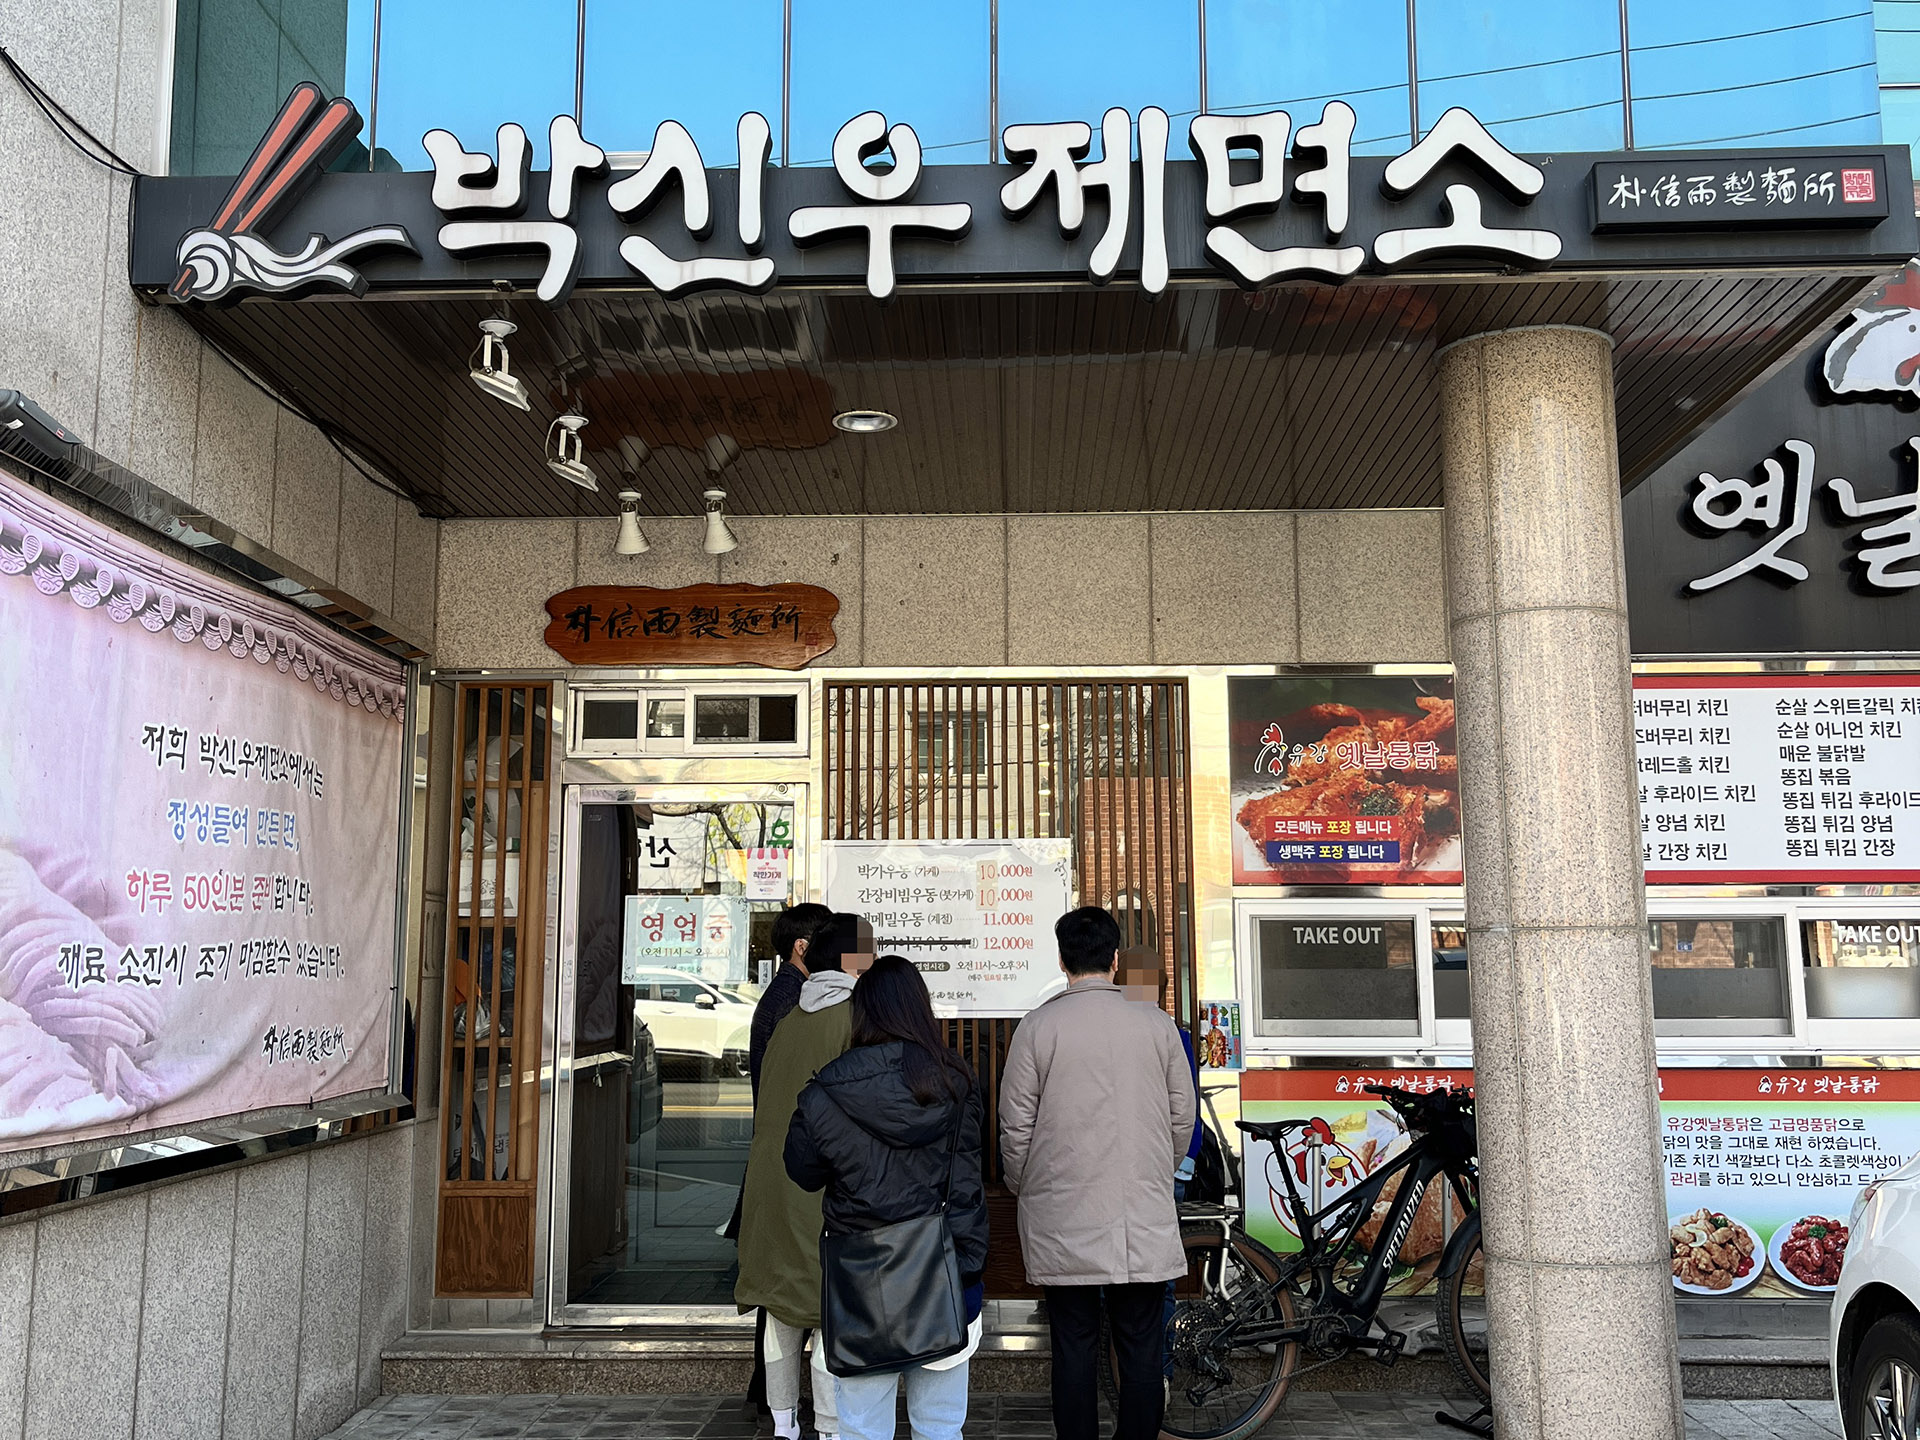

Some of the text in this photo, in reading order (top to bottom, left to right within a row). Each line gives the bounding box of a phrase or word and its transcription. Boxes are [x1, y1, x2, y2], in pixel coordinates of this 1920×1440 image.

[422, 101, 1562, 300] 박신우제면소
[1697, 699, 1729, 716] 치킨
[1775, 698, 1920, 716] 순살 스위트갈릭 치
[1699, 728, 1731, 745] 치킨
[1777, 721, 1902, 739] 순살 어니언 치킨
[142, 725, 324, 798] 저희 박신우제면소에서는
[1287, 741, 1440, 770] 유강 옛날통닭
[1779, 744, 1866, 763] 매운 불닭발
[1698, 756, 1730, 774] 치킨
[1781, 768, 1851, 786] 똥집 볶음
[1654, 785, 1719, 803] 후라이드
[1724, 785, 1756, 803] 치킨
[1783, 791, 1815, 810] 똥집
[1820, 791, 1853, 809] 튀김
[167, 801, 248, 846] 정성들여
[1274, 820, 1392, 835] 모든메뉴 포장 됩니다
[1656, 814, 1688, 832] 양념
[1694, 814, 1725, 832] 치킨
[1784, 815, 1893, 833] 똥집 튀김 양념
[1278, 844, 1384, 859] 생맥주 포장 됩니다
[1658, 843, 1690, 861] 간장
[1695, 843, 1728, 861] 치킨
[1786, 838, 1896, 857] 똥집 튀김 간장
[857, 864, 911, 880] 박가우동
[127, 869, 172, 913] 하루
[183, 873, 245, 912] 50인분
[857, 887, 938, 904] 간장비빔우동
[1292, 926, 1383, 945] TAKE OUT
[1838, 925, 1883, 944] TAKE
[58, 943, 106, 989] 재료
[117, 944, 187, 986] 소진시
[195, 943, 232, 981] 조기
[296, 942, 345, 979] 있습니다.
[1775, 1075, 1880, 1094] 유강 옛날통닭
[1667, 1117, 1866, 1132] 유강옛날통닭은 고급명품닭으로
[1695, 1135, 1723, 1150] 맛을
[1728, 1135, 1770, 1150] 그대로
[1774, 1135, 1802, 1151] 재현
[1807, 1135, 1881, 1151] 하였습니다.
[1693, 1154, 1720, 1169] 치킨
[1725, 1154, 1780, 1169] 색깔보다
[1786, 1154, 1813, 1169] 다소
[1819, 1154, 1903, 1170] 초콜렛색상이
[1670, 1172, 1711, 1187] 관리를
[1717, 1172, 1745, 1187] 하고
[1749, 1172, 1791, 1187] 있으니
[1796, 1172, 1853, 1188] 안심하고
[1382, 1179, 1425, 1274] SPECIALIZED
